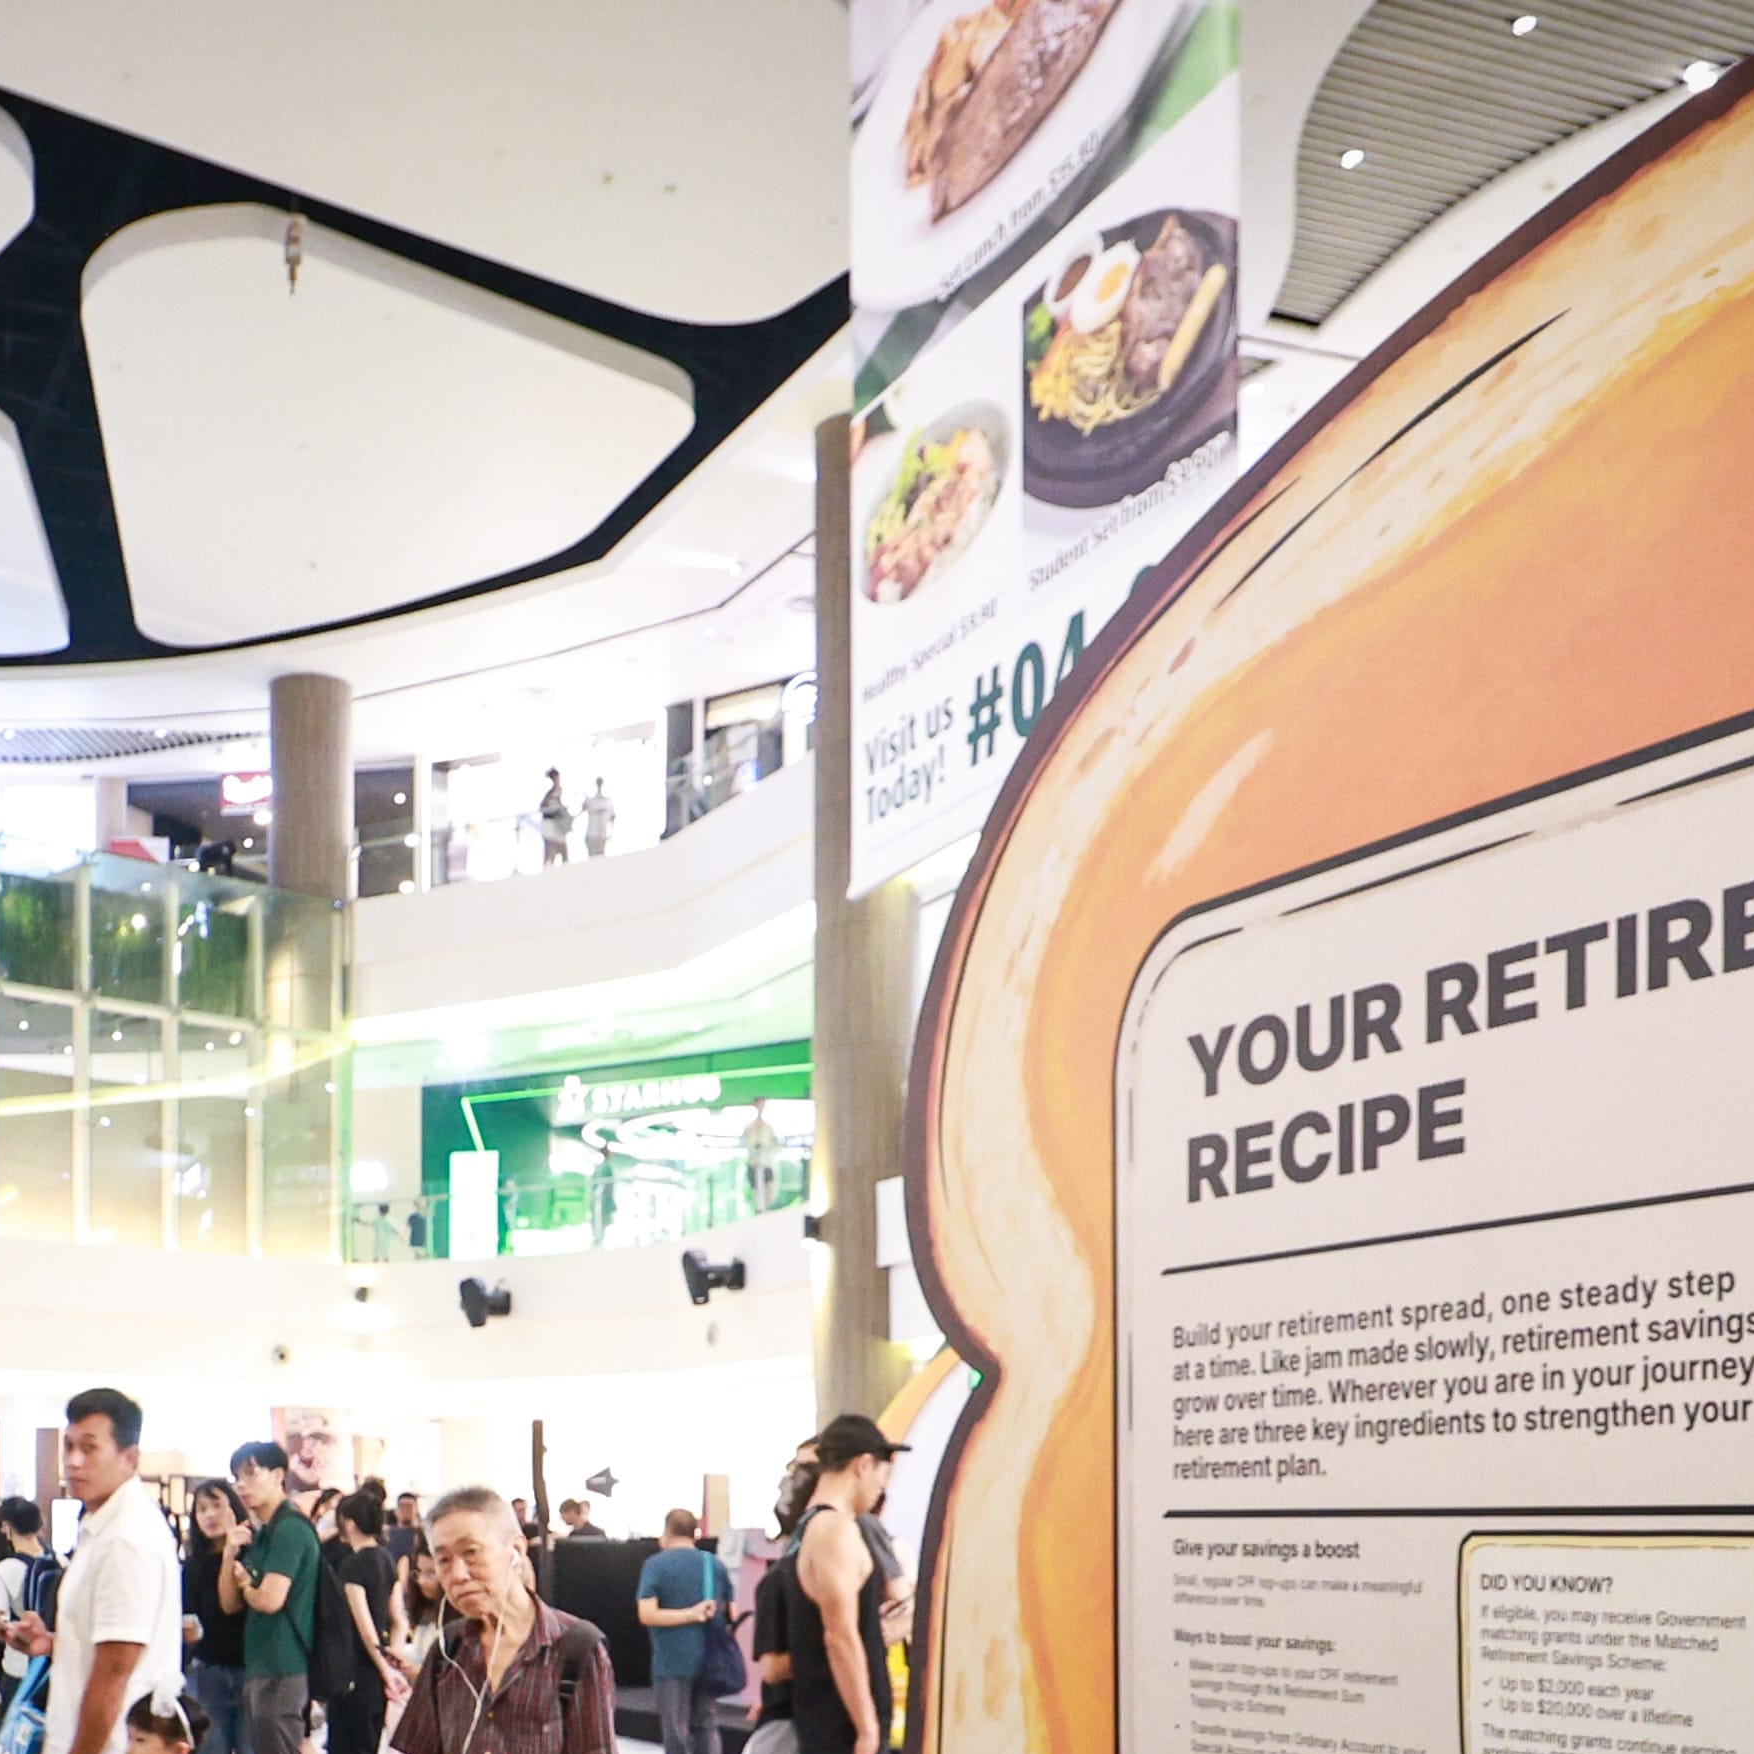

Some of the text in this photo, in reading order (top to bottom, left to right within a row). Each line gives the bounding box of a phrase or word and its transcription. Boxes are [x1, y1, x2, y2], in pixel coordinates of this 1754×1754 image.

[865, 697, 953, 776] Visit us
[867, 744, 946, 824] Today!
[1187, 982, 1402, 1097] YOUR
[1187, 1078, 1465, 1203] RECIPE
[1173, 1271, 1734, 1348] Build your retirement spread, one steady step
[1174, 1454, 1326, 1481] retirement plan.
[1174, 1538, 1203, 1555] Give
[1207, 1543, 1238, 1560] your
[1242, 1543, 1298, 1561] savings
[1315, 1541, 1359, 1558] boost
[1480, 1573, 1612, 1592] DID YOU KNOW?
